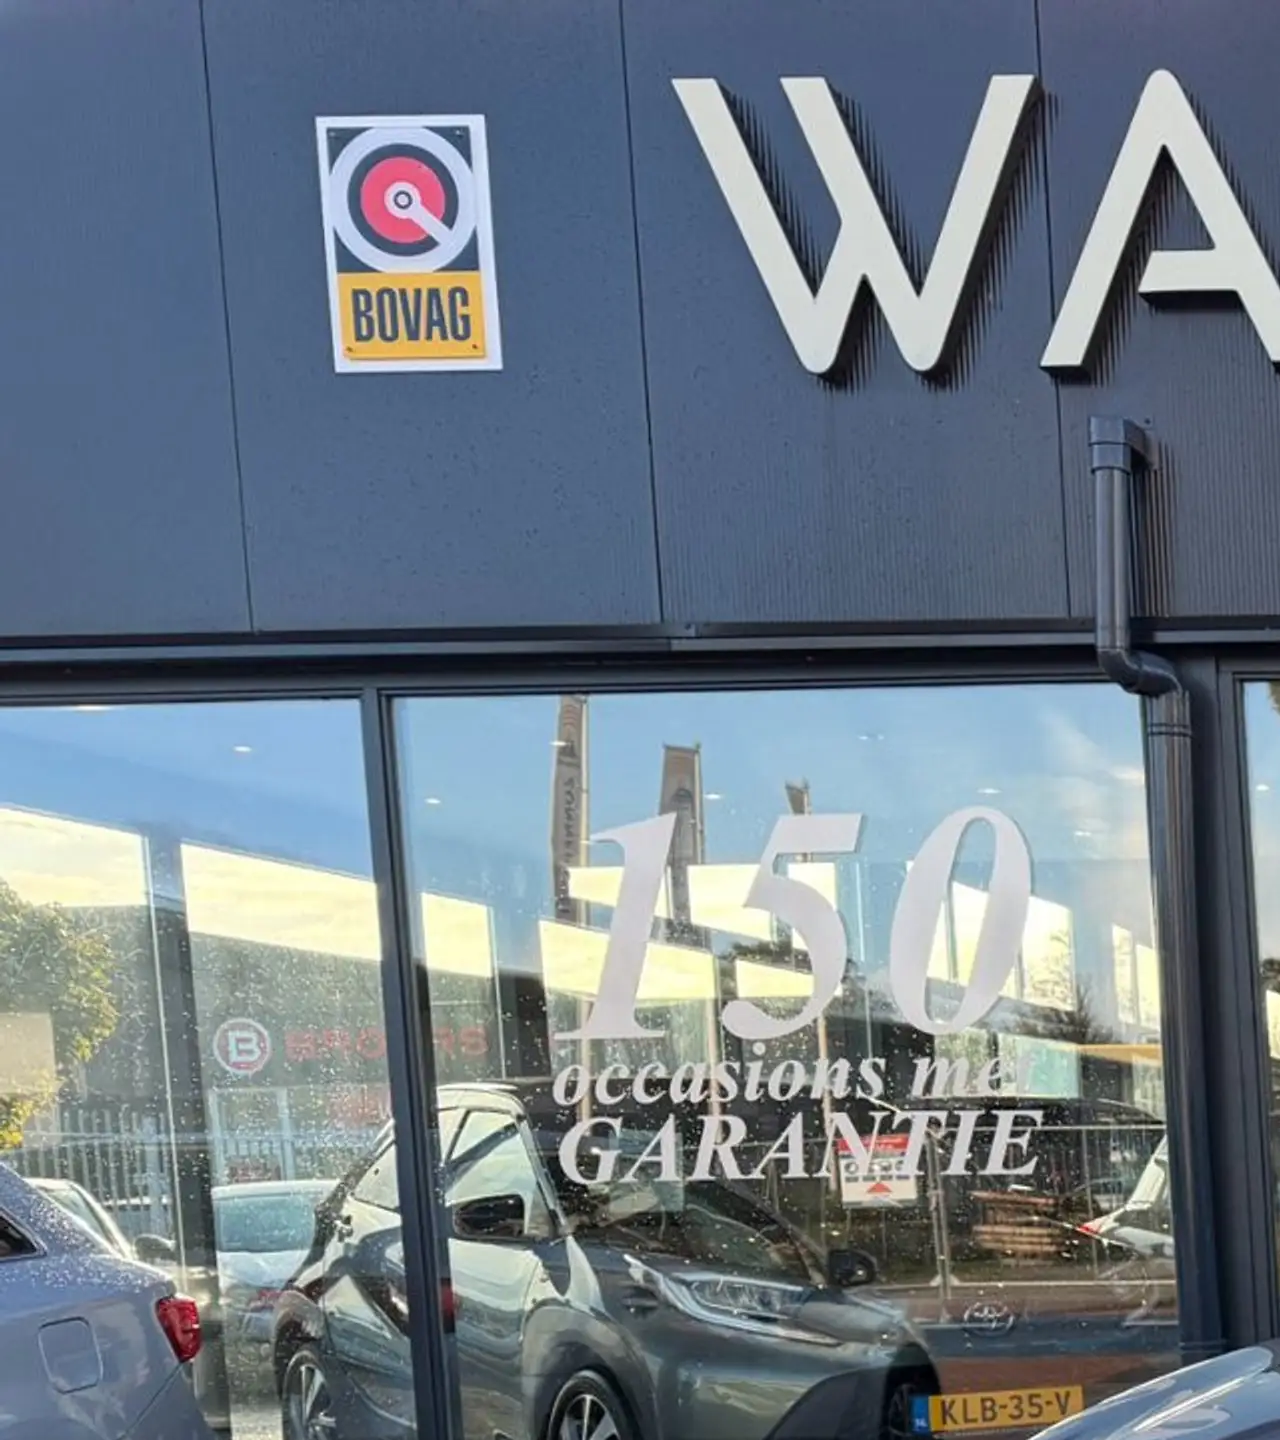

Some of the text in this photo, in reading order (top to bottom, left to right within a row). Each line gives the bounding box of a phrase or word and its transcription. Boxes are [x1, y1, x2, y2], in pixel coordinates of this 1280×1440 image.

[351, 285, 471, 345] BOVAG
[554, 805, 1033, 1041] 150
[554, 1043, 1034, 1106] occasions met
[557, 1108, 1045, 1185] GARANTIE
[940, 1390, 1072, 1425] KLB-35-V
